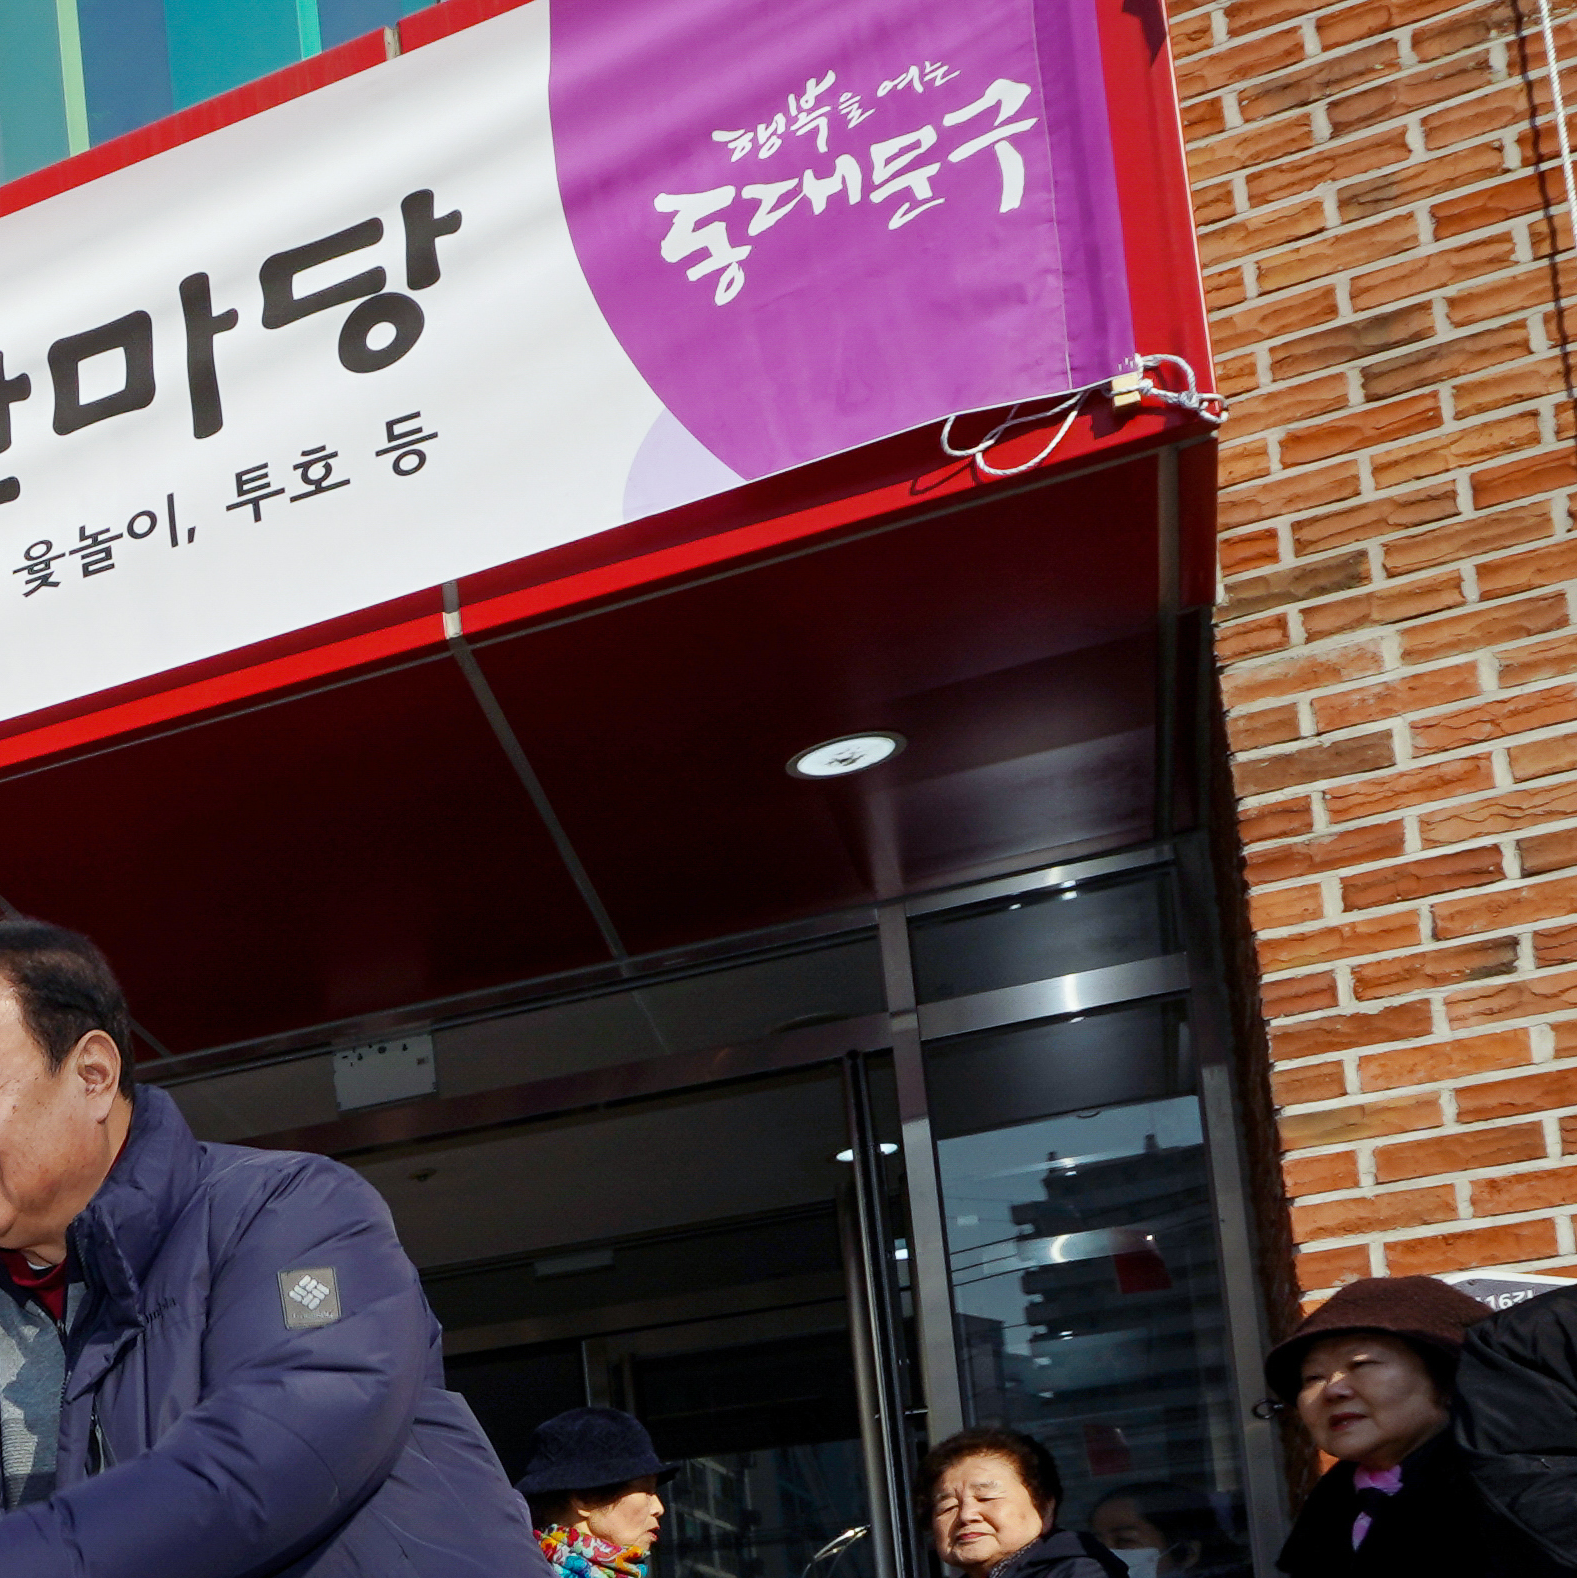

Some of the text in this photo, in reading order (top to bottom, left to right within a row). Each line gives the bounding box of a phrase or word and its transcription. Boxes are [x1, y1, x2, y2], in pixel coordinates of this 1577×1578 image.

[652, 78, 1040, 307] 동대문구
[711, 60, 962, 163] 행복을 여는
[11, 491, 196, 598] 윷놀이,
[224, 444, 351, 523] 투호
[373, 410, 439, 477] 등
